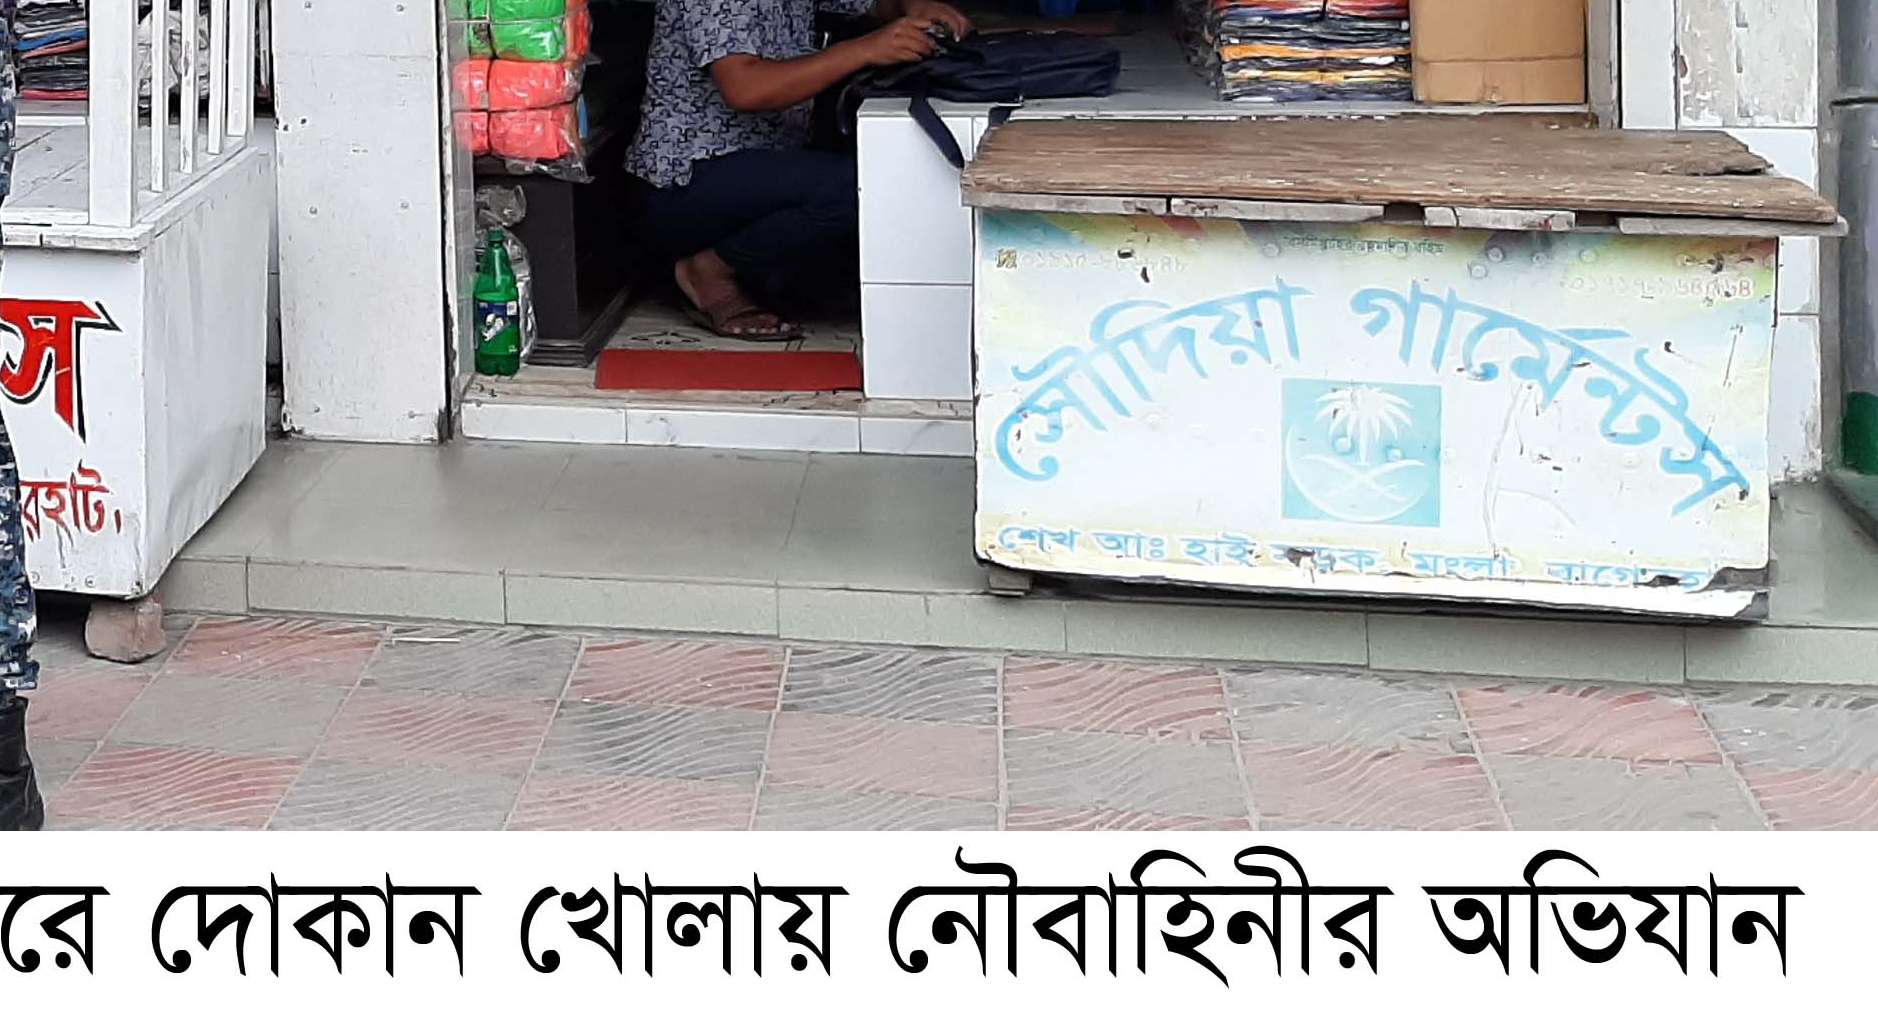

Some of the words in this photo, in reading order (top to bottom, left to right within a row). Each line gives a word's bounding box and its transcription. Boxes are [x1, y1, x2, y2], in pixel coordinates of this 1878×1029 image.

[996, 277, 1314, 482] সৌদিয়া
[1350, 279, 1751, 517] গার্মেন্টস
[997, 526, 1080, 554] শেখ
[1089, 530, 1166, 561] আঃ
[1178, 532, 1260, 567] হাই
